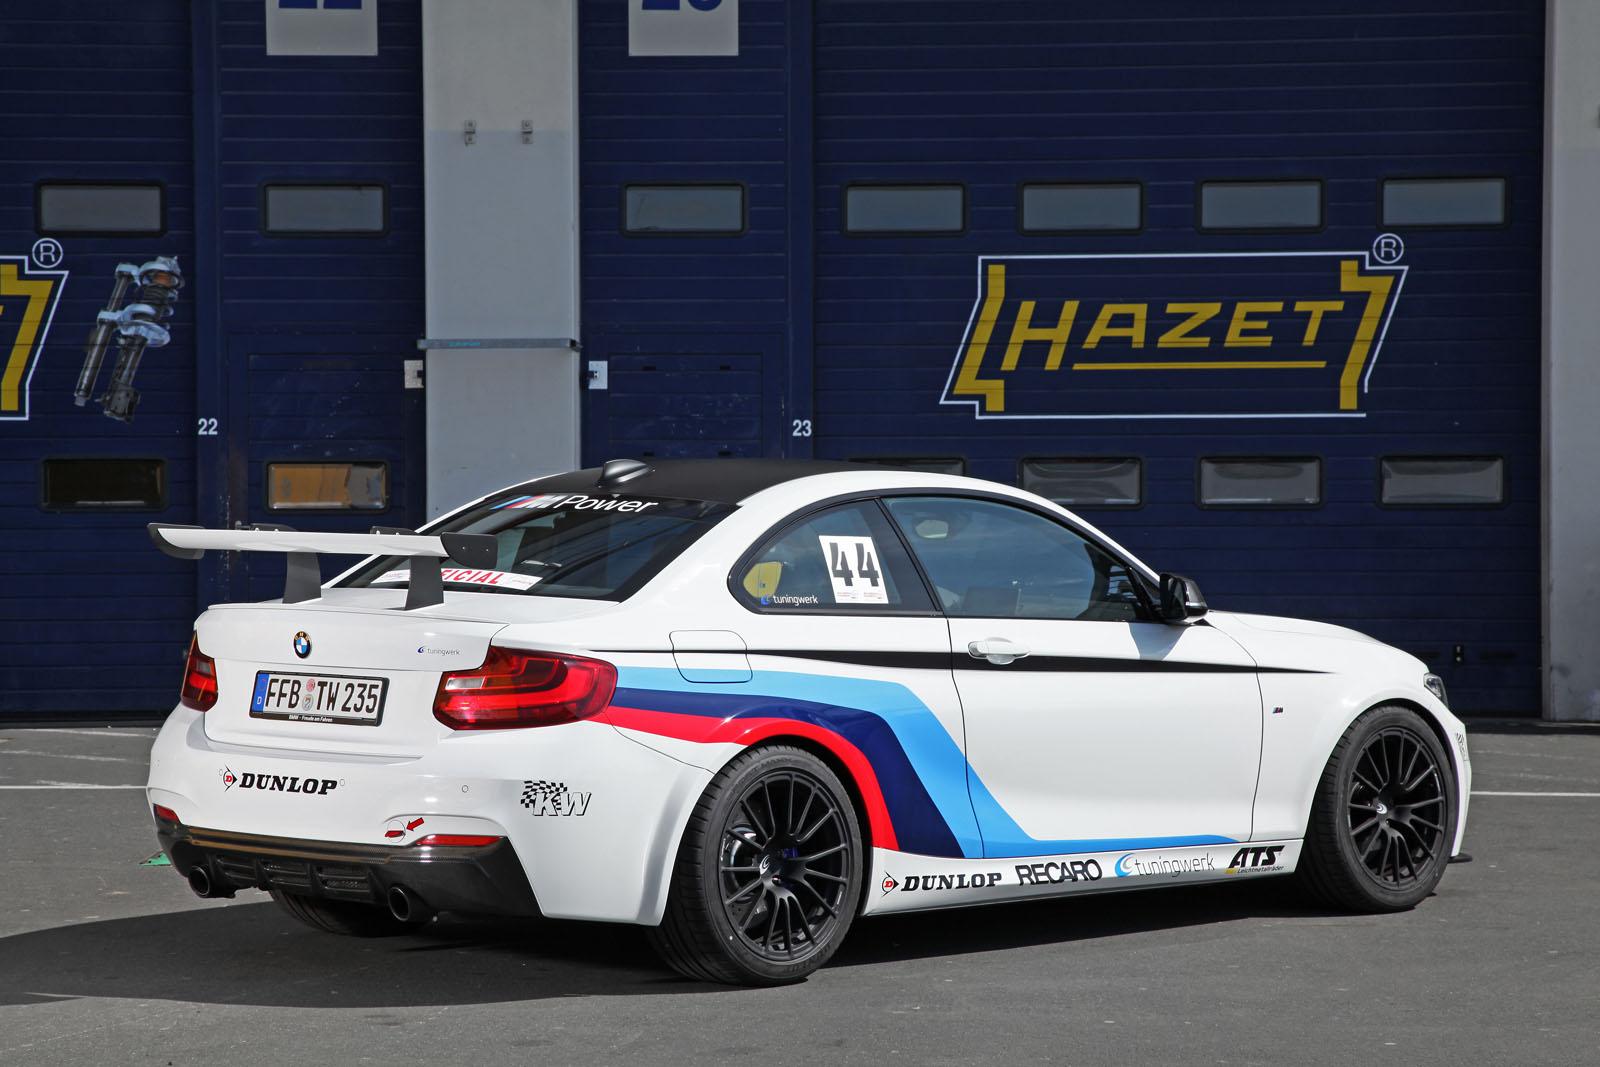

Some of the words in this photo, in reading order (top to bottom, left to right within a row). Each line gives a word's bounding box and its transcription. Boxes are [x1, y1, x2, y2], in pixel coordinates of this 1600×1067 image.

[1000, 300, 1345, 371] HAZET
[198, 418, 218, 435] 22
[792, 419, 812, 437] 23
[553, 495, 659, 512] Power
[829, 542, 880, 587] 44
[440, 569, 504, 584] FICIAL
[773, 595, 818, 606] tuningwerk
[427, 648, 461, 656] tuningwerk
[256, 696, 263, 705] D
[265, 679, 301, 709] FFB
[316, 680, 341, 711] TW
[341, 682, 380, 713] 235
[239, 772, 338, 795] DUNLOP
[532, 791, 592, 816] KW
[1135, 852, 1215, 878] tuningwerk
[1228, 845, 1286, 869] ATS
[900, 873, 1002, 892] DUNLOP
[1015, 859, 1103, 886] RECARO
